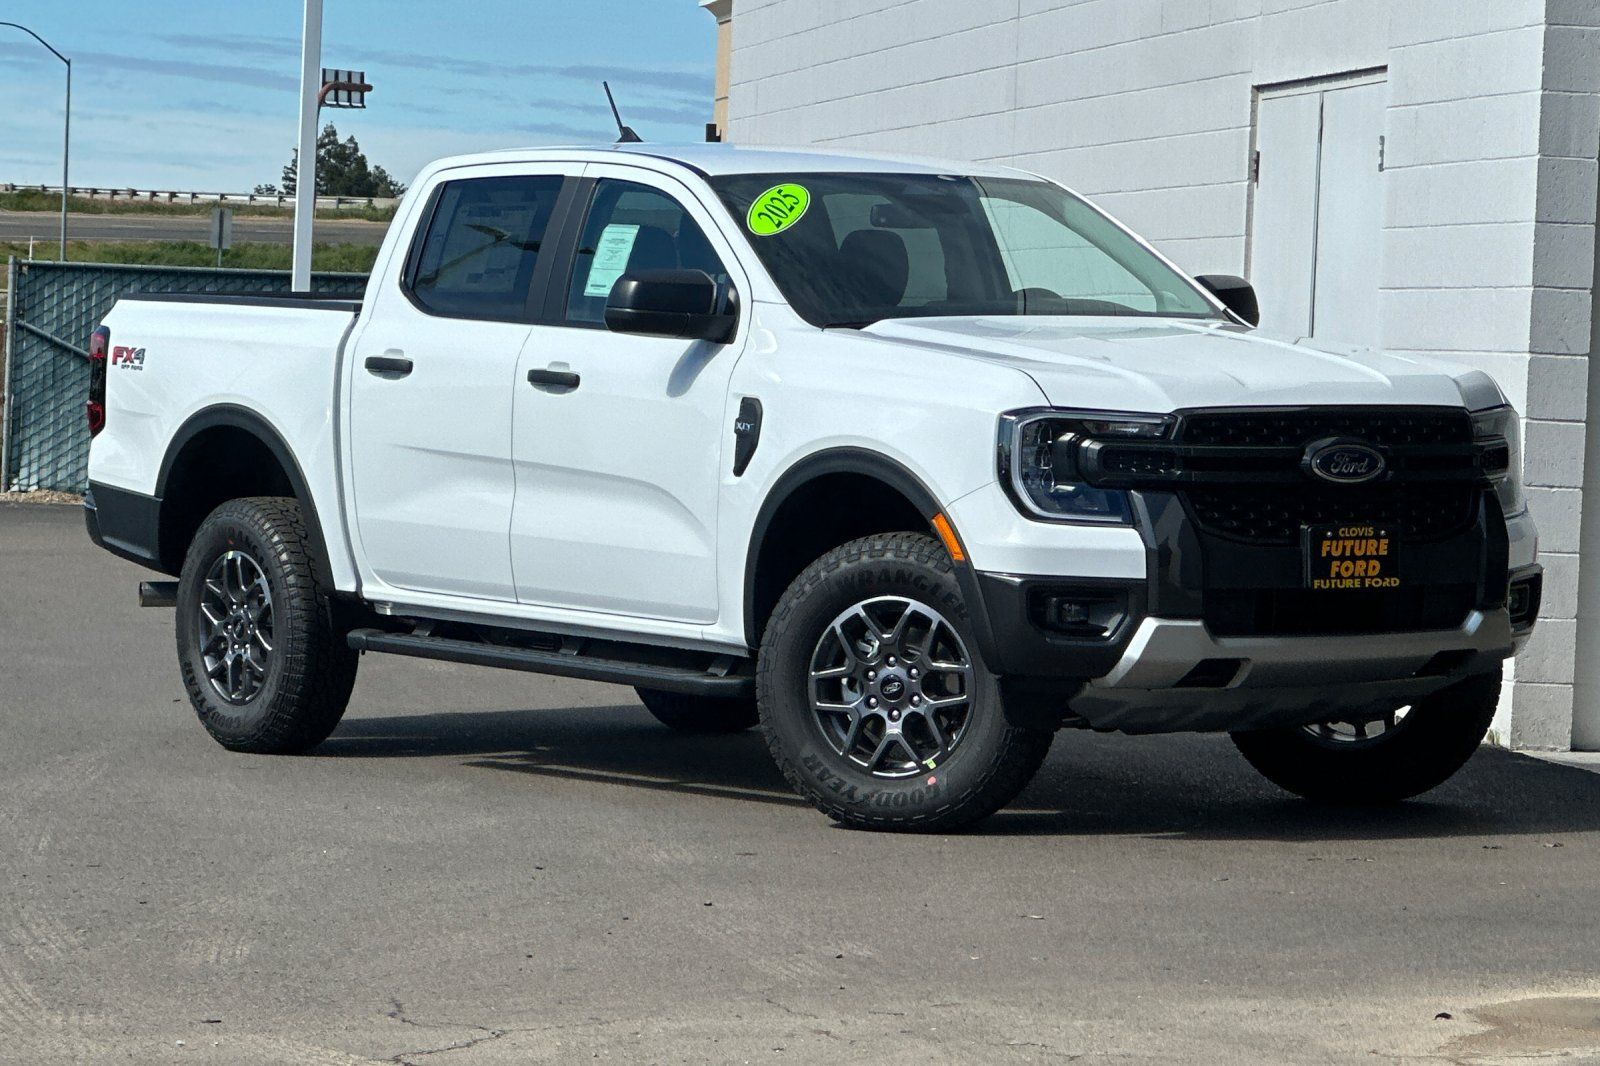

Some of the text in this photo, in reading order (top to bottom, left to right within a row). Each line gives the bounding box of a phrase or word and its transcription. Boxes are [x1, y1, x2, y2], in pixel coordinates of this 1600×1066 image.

[758, 189, 800, 229] 2025
[112, 346, 146, 365] FX4
[1330, 452, 1369, 474] Ford
[1338, 527, 1374, 537] CLOVIS
[1321, 538, 1389, 557] FUTURE
[1330, 559, 1381, 577] FORD
[1313, 577, 1400, 589] FUTURE FORD
[802, 752, 941, 807] GOODYEAR
